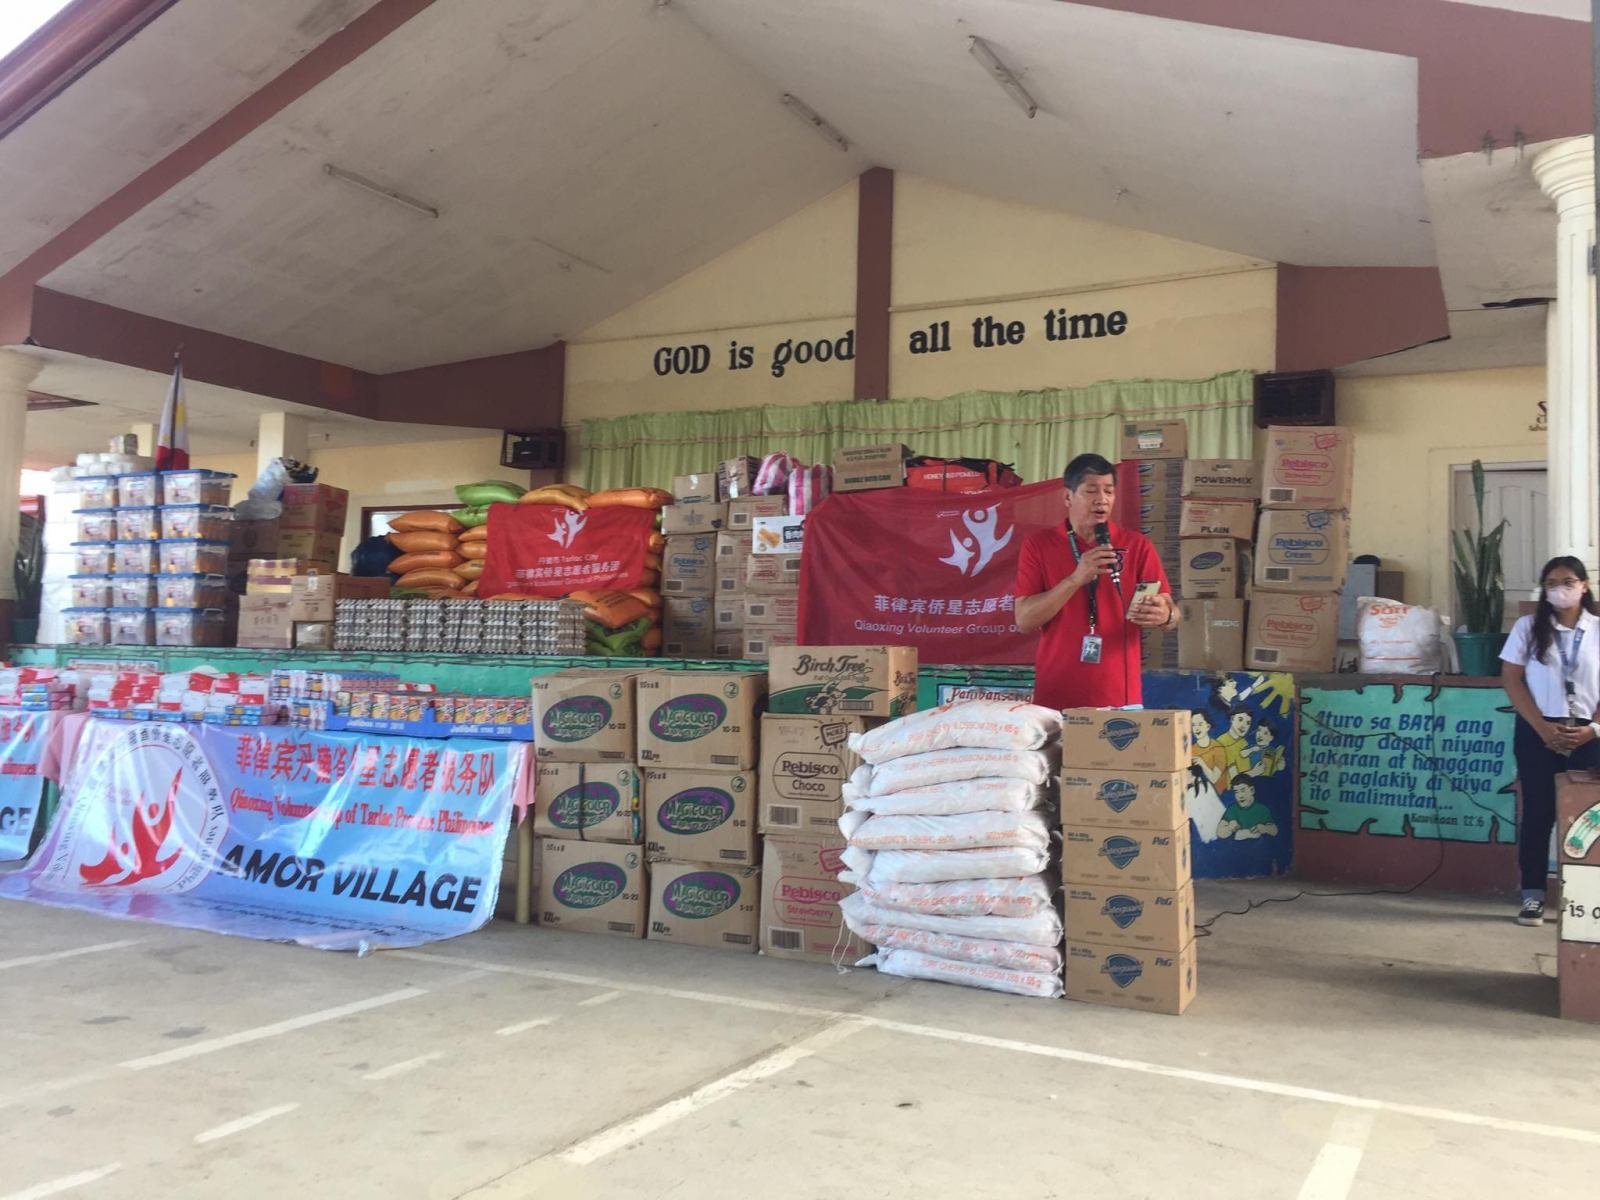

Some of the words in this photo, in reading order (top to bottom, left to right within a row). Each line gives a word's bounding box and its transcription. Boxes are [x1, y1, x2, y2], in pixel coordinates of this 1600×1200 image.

[654, 344, 711, 376] GOD
[728, 341, 754, 370] is
[771, 329, 856, 378] good
[909, 321, 951, 354] all
[972, 316, 1025, 348] the
[1044, 308, 1128, 341] time
[1194, 475, 1252, 485] POWERMIX
[1200, 525, 1230, 534] PLAIN
[854, 619, 904, 635] Qiaoxing
[907, 623, 963, 635] Volunteer
[966, 624, 1005, 636] Group
[792, 654, 834, 676] Birch
[834, 655, 867, 675] Tree
[1371, 717, 1392, 730] sa
[1400, 714, 1446, 732] BATA
[1455, 719, 1494, 737] ang
[1378, 733, 1434, 752] dapat
[1442, 737, 1505, 758] niyang
[782, 760, 839, 778] Rebisco
[1311, 749, 1379, 768] lakaran
[1388, 755, 1406, 769] at
[1413, 754, 1504, 776] hanggang
[792, 779, 826, 792] Choco
[1309, 770, 1329, 785] sa
[1426, 774, 1442, 790] di
[1451, 777, 1493, 794] niya
[1310, 787, 1331, 801] ito
[345, 802, 357, 824] of
[216, 844, 325, 893] AMOR
[332, 861, 482, 913] VILLAGE
[782, 884, 840, 904] Rebisco
[1569, 900, 1585, 917] is
